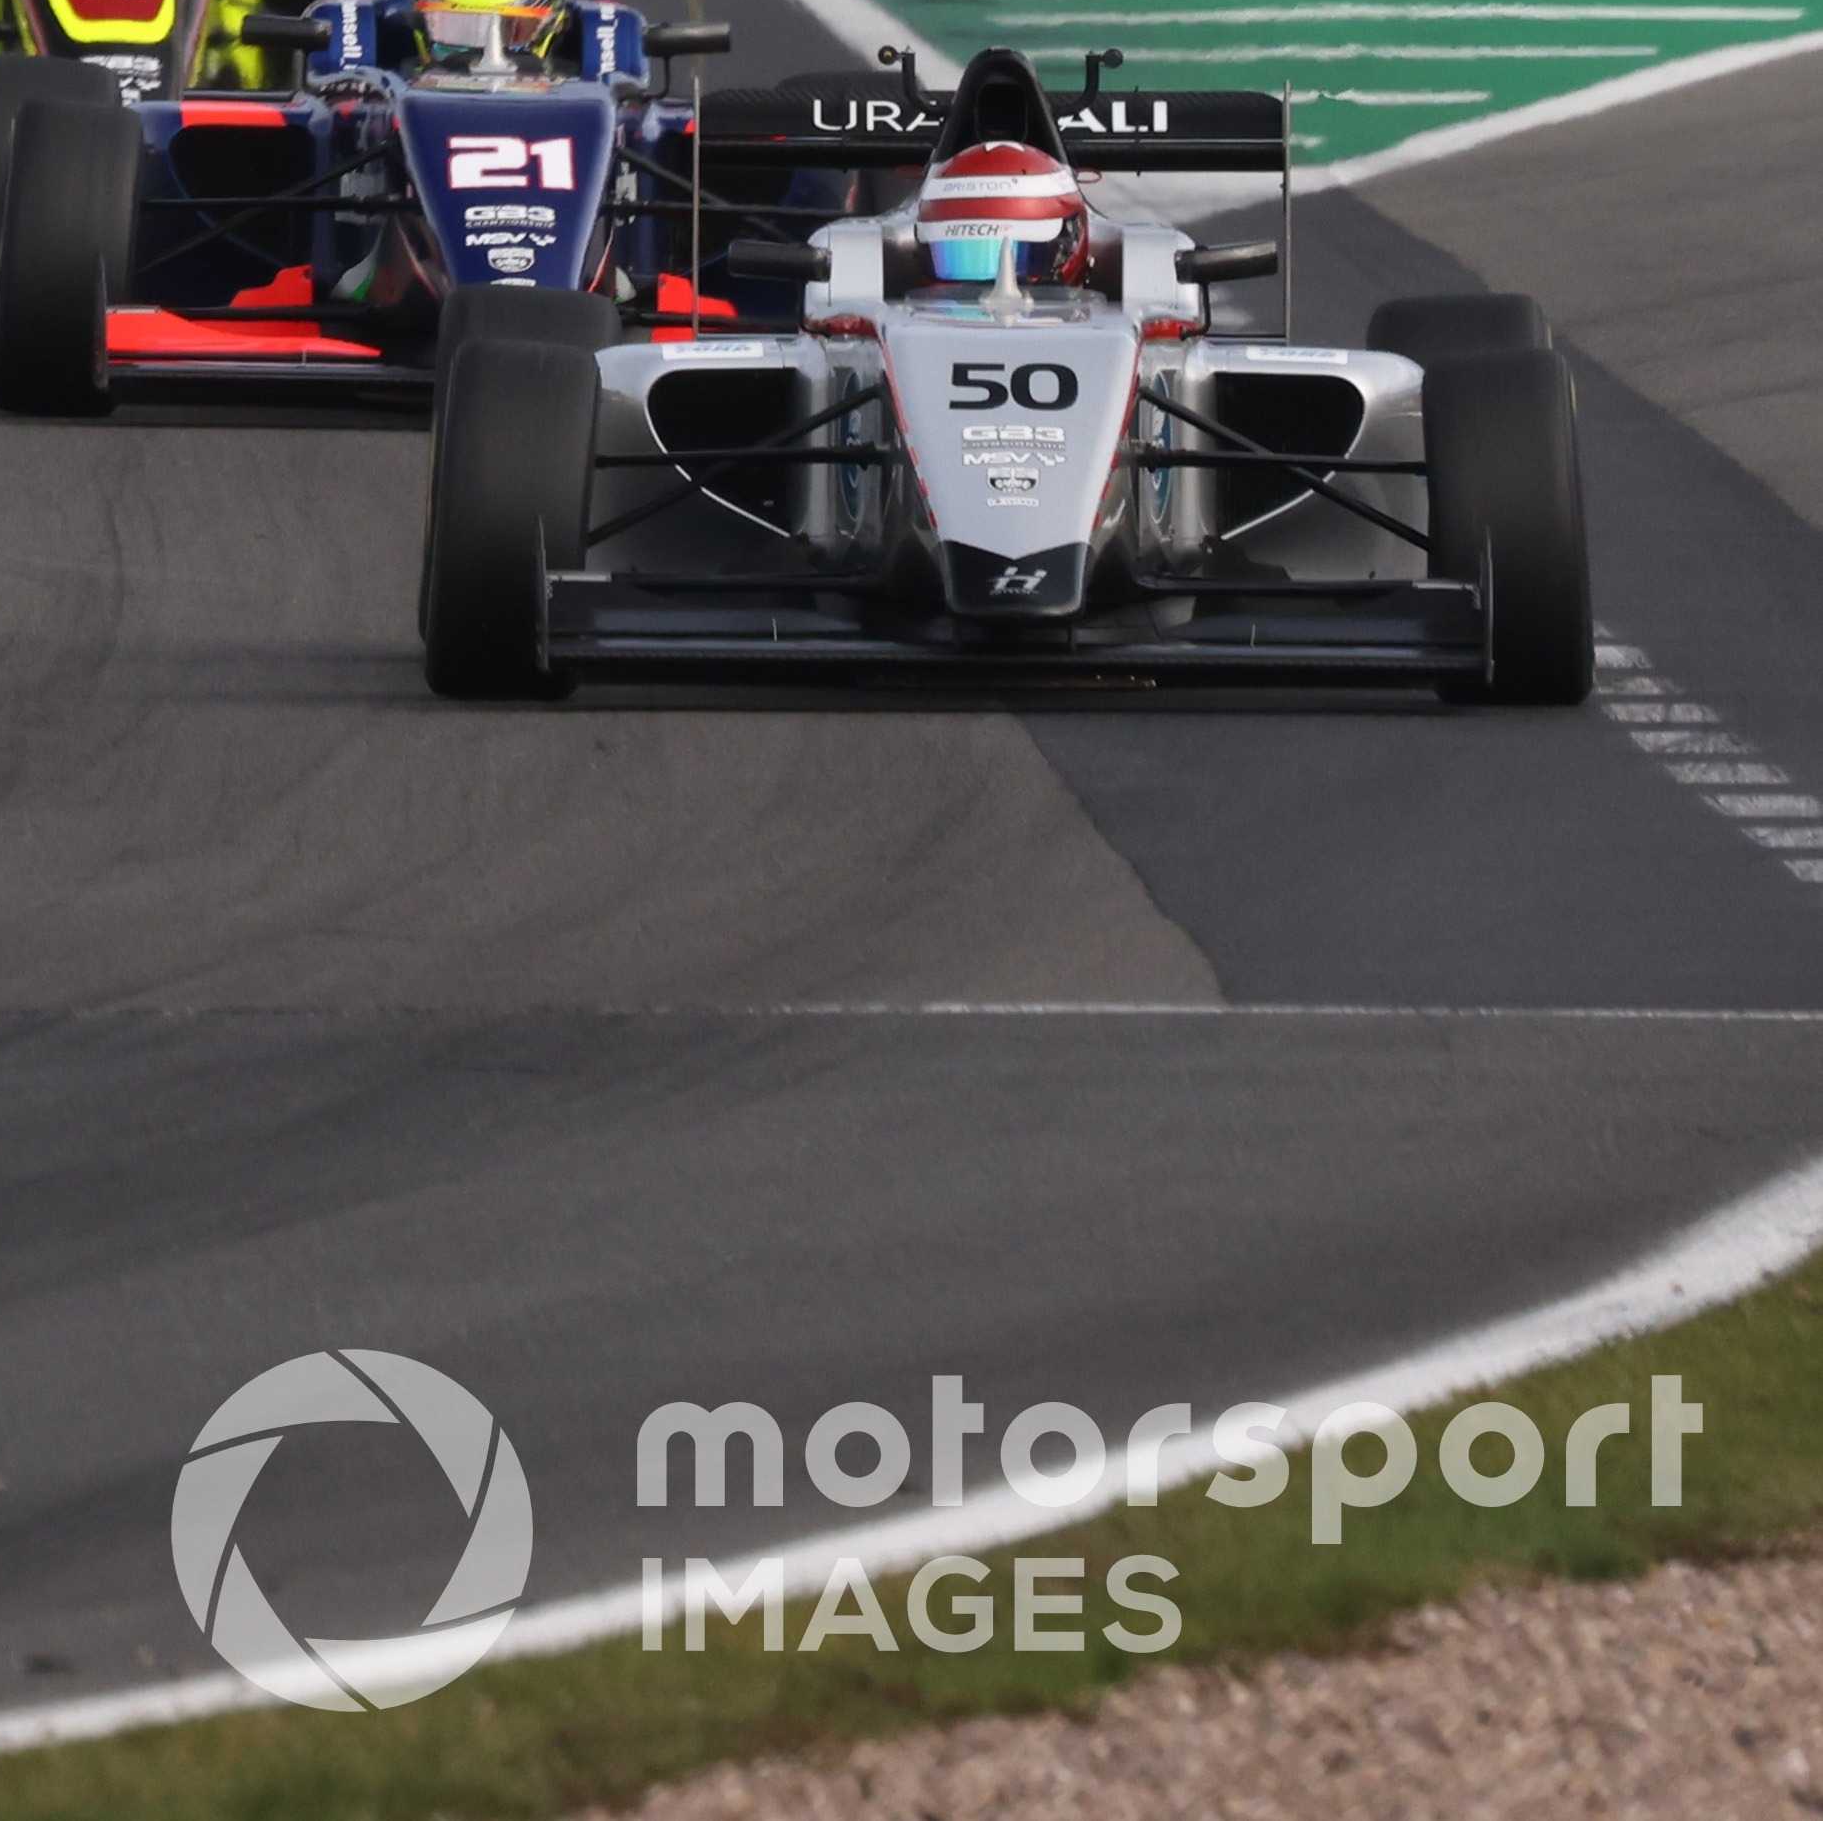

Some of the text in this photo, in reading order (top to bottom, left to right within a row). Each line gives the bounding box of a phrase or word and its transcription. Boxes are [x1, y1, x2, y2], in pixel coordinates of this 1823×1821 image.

[446, 135, 576, 194] 21
[465, 205, 557, 222] GB3
[945, 224, 1000, 237] HITECH
[465, 232, 528, 247] MSV
[949, 363, 1079, 411] 50
[962, 425, 1065, 442] GB3
[963, 452, 1031, 466] MSV
